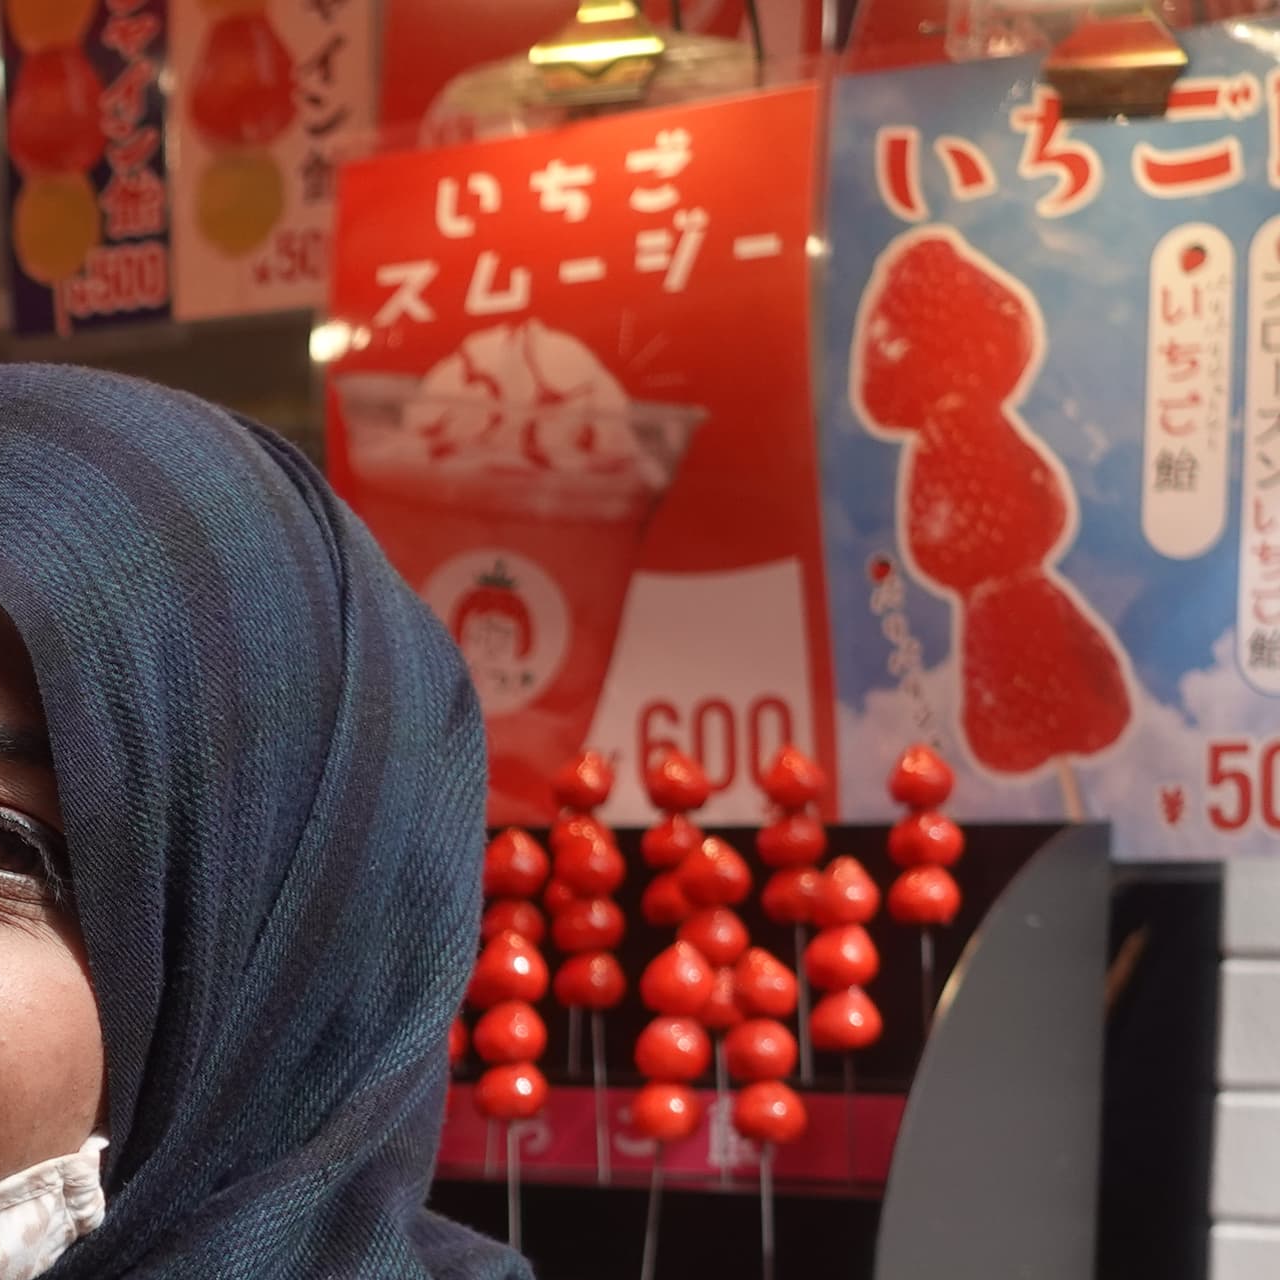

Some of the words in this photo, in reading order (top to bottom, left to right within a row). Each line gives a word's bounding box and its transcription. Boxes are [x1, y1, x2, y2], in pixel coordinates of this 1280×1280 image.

[436, 128, 692, 237] いちご
[875, 70, 1280, 222] いちご
[375, 207, 783, 325] スムージー
[1153, 285, 1203, 493] いちご飴
